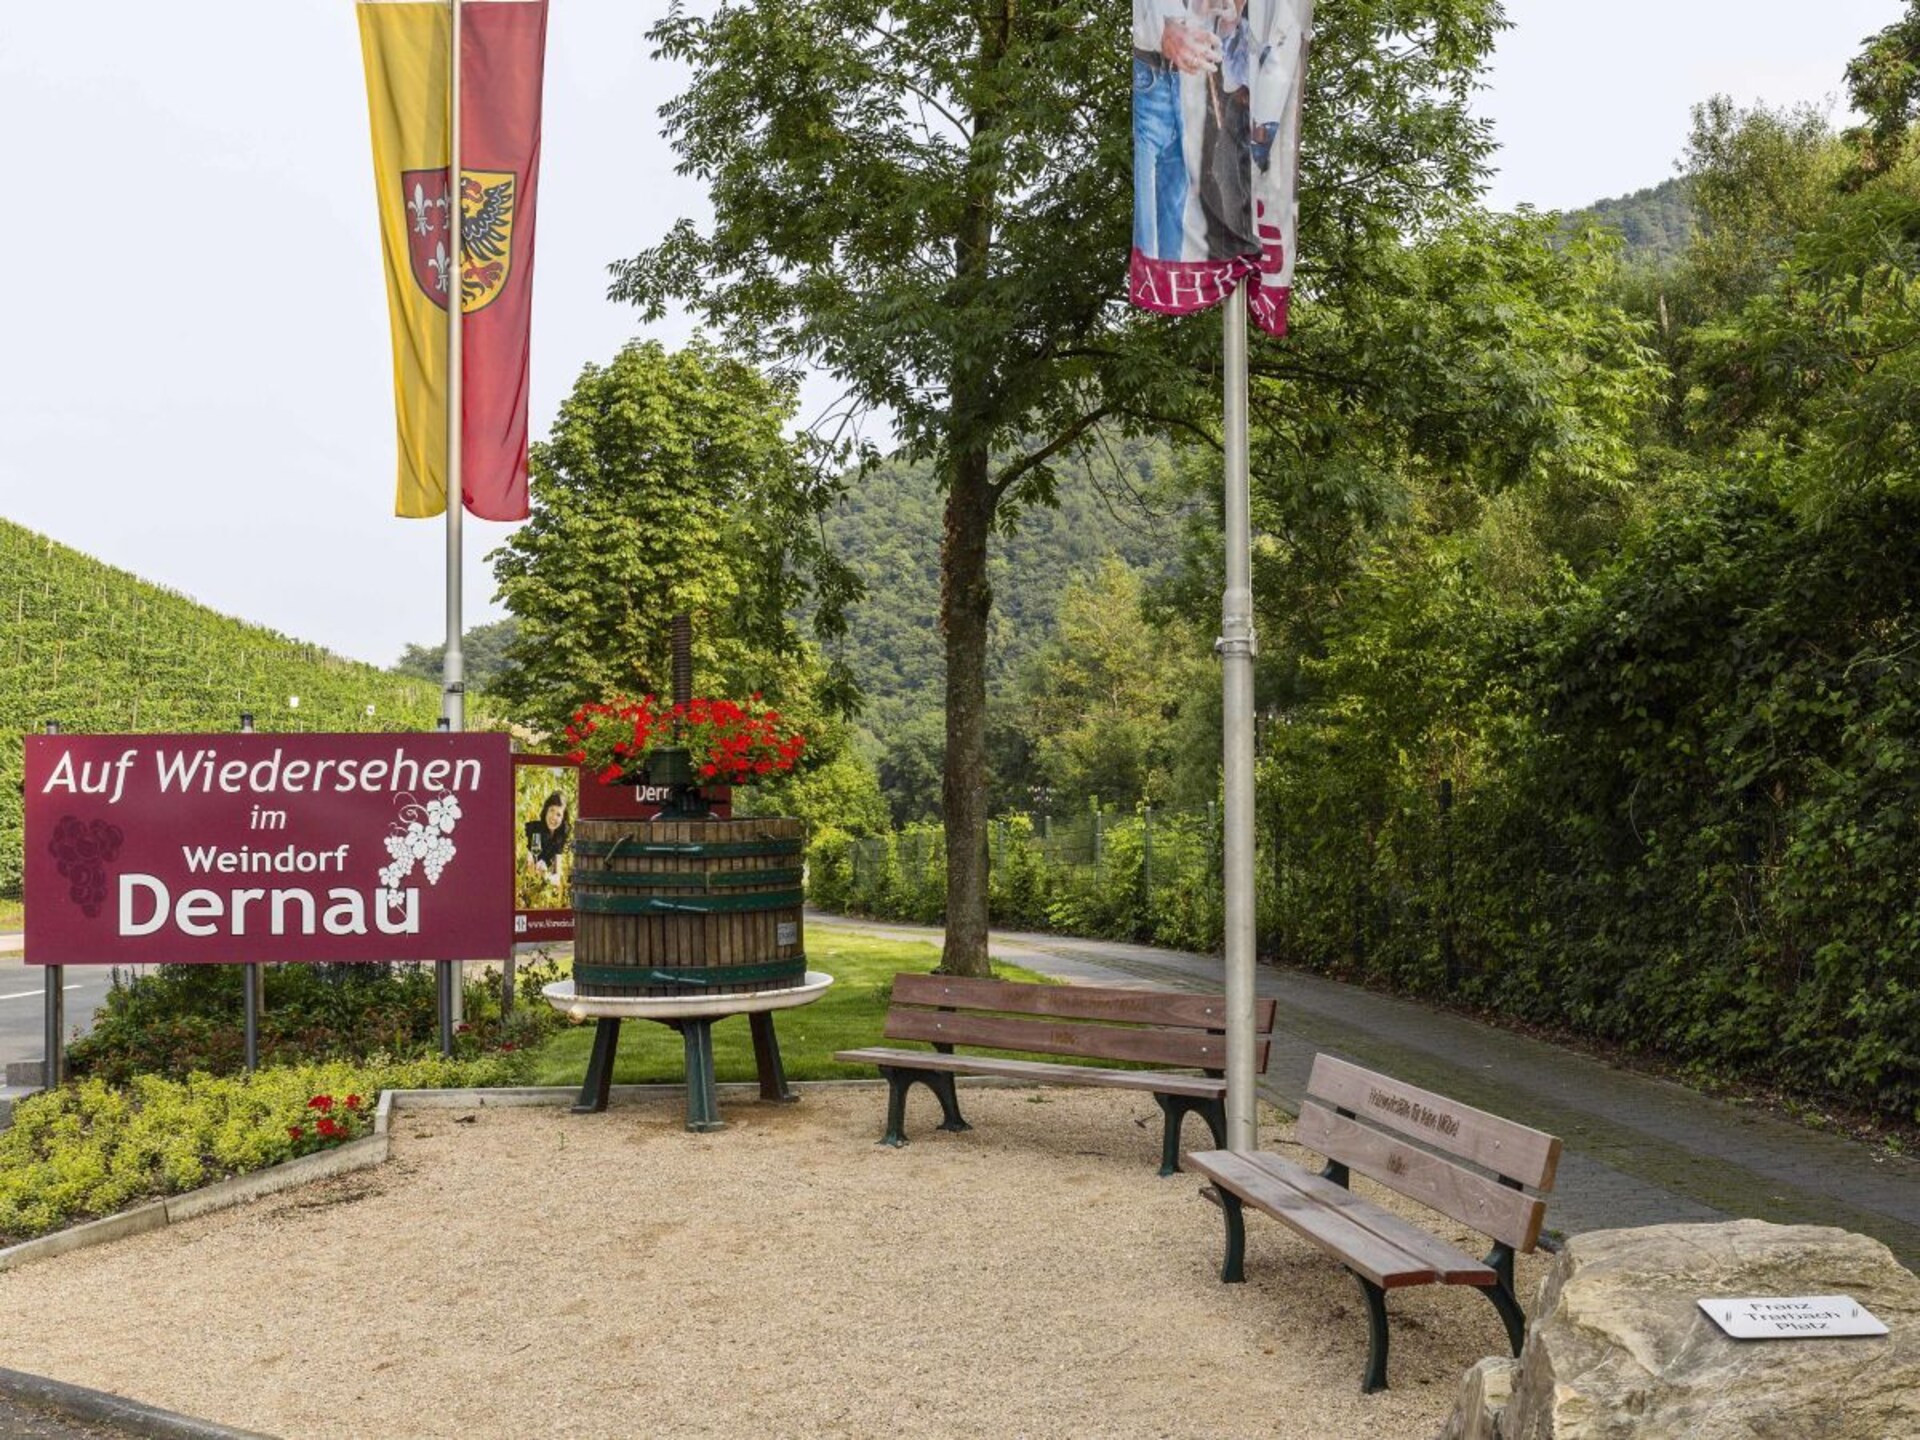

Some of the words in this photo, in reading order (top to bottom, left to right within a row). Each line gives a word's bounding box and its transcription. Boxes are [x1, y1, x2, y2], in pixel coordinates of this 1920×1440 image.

[43, 749, 137, 802] Auf
[156, 749, 481, 792] Wiedersehen
[250, 804, 286, 830] im
[182, 845, 349, 873] Weindorf
[118, 873, 419, 935] Dernau
[1749, 1303, 1811, 1311] Franz
[1775, 1322, 1830, 1330] Platz
